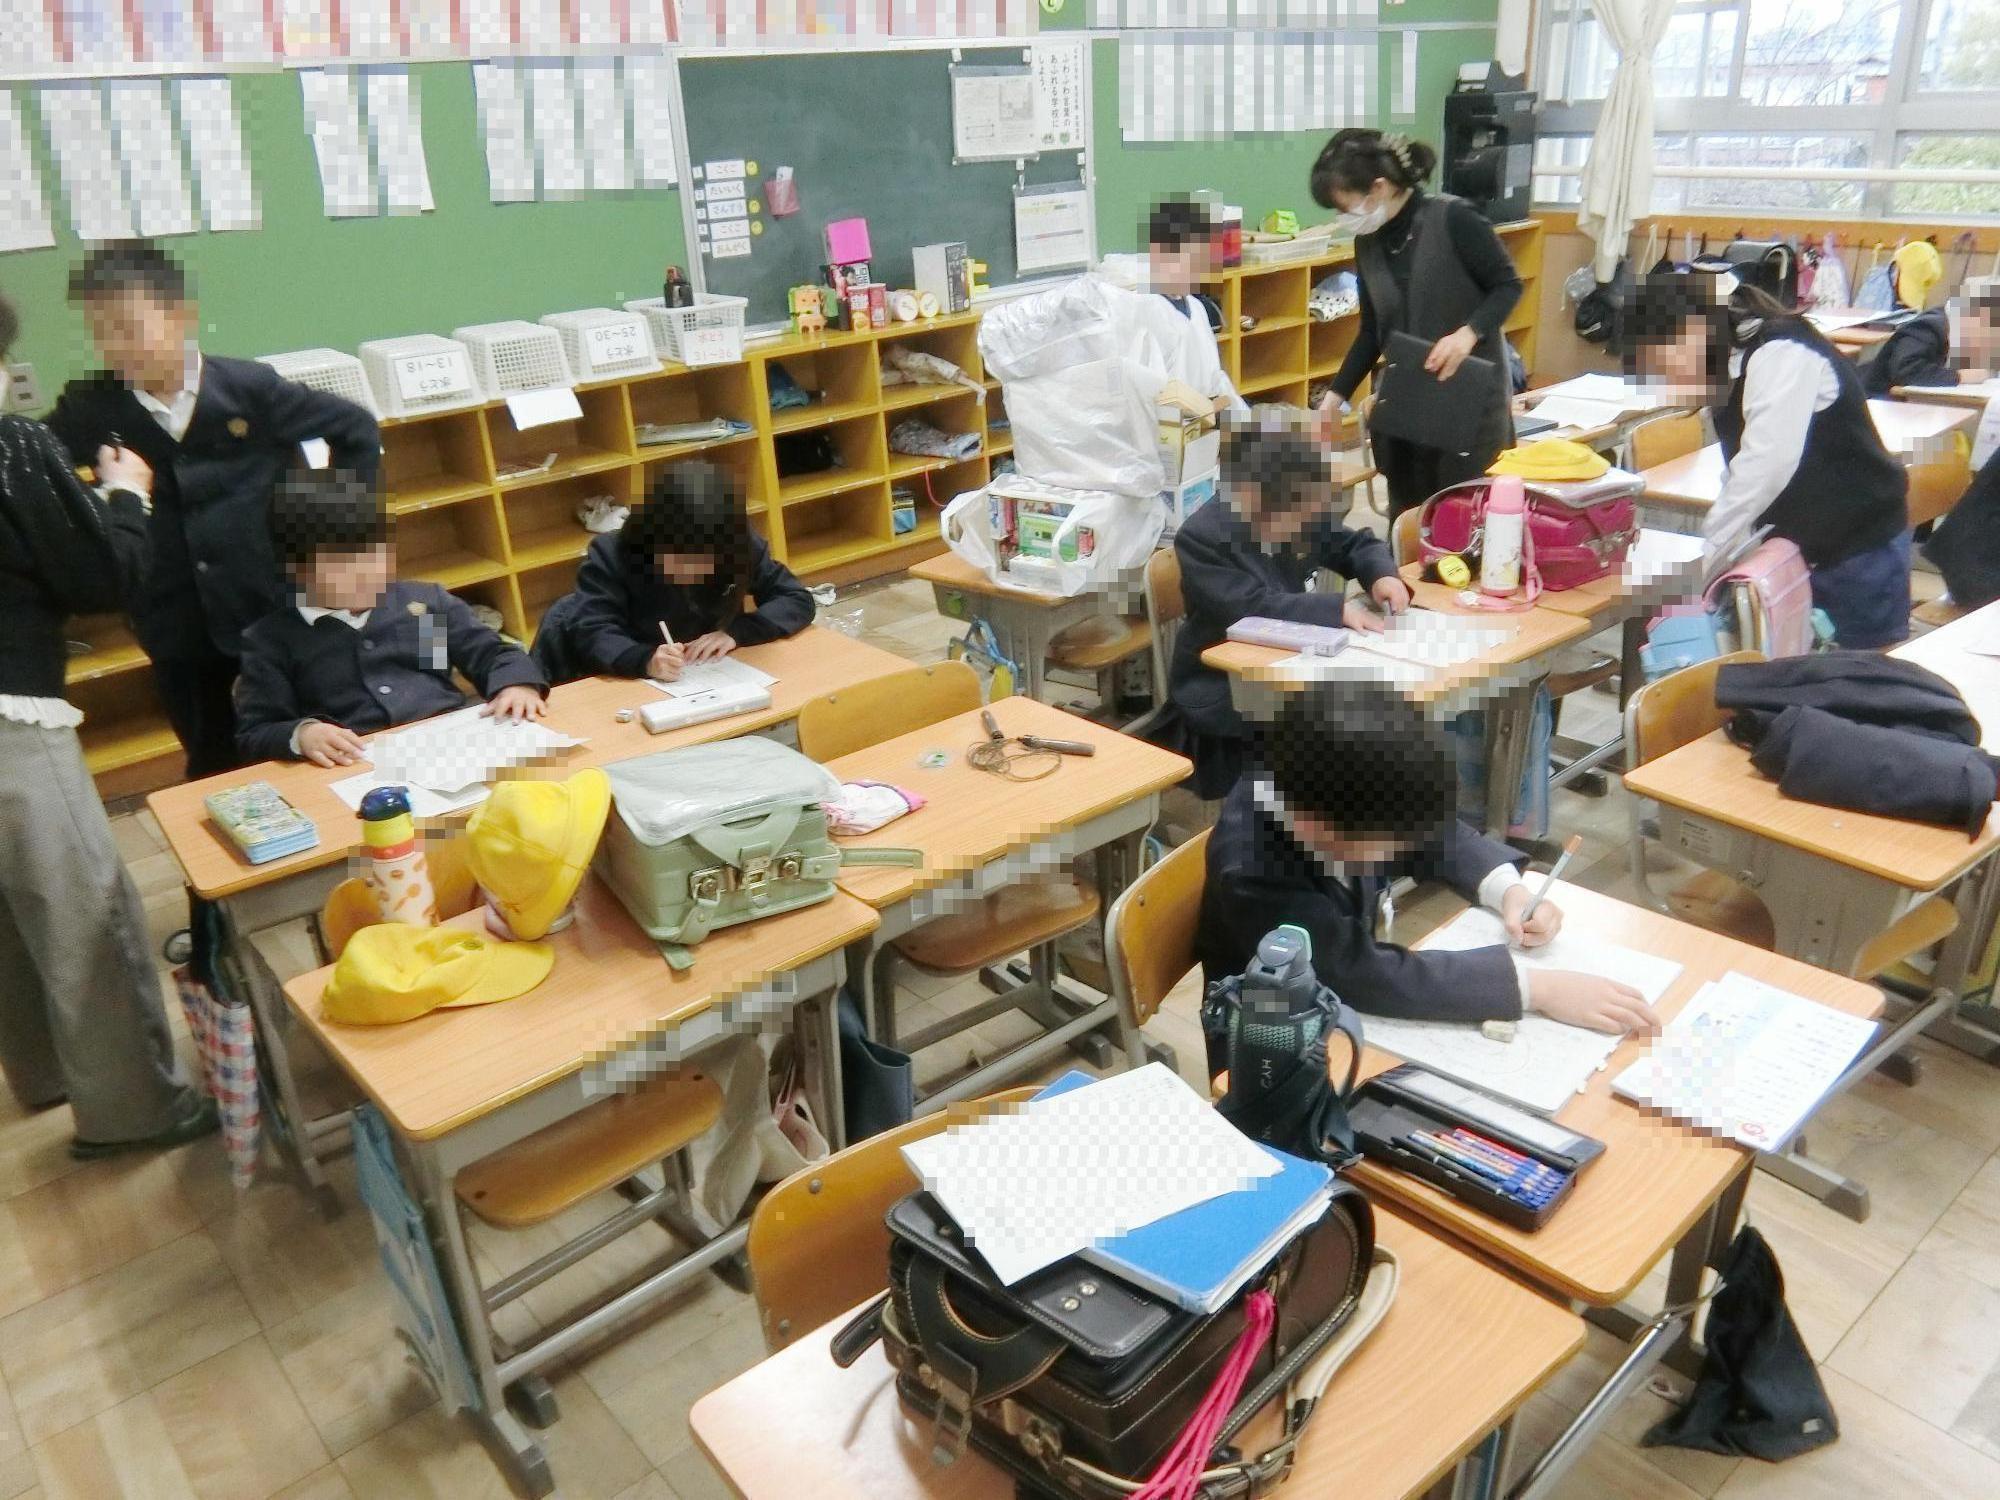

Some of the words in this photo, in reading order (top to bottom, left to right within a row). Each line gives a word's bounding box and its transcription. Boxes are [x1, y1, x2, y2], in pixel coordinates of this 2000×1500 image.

[1050, 54, 1060, 128] あふれる学校に
[1061, 52, 1071, 128] ふわふわ言葉の
[710, 183, 744, 197] たいいく
